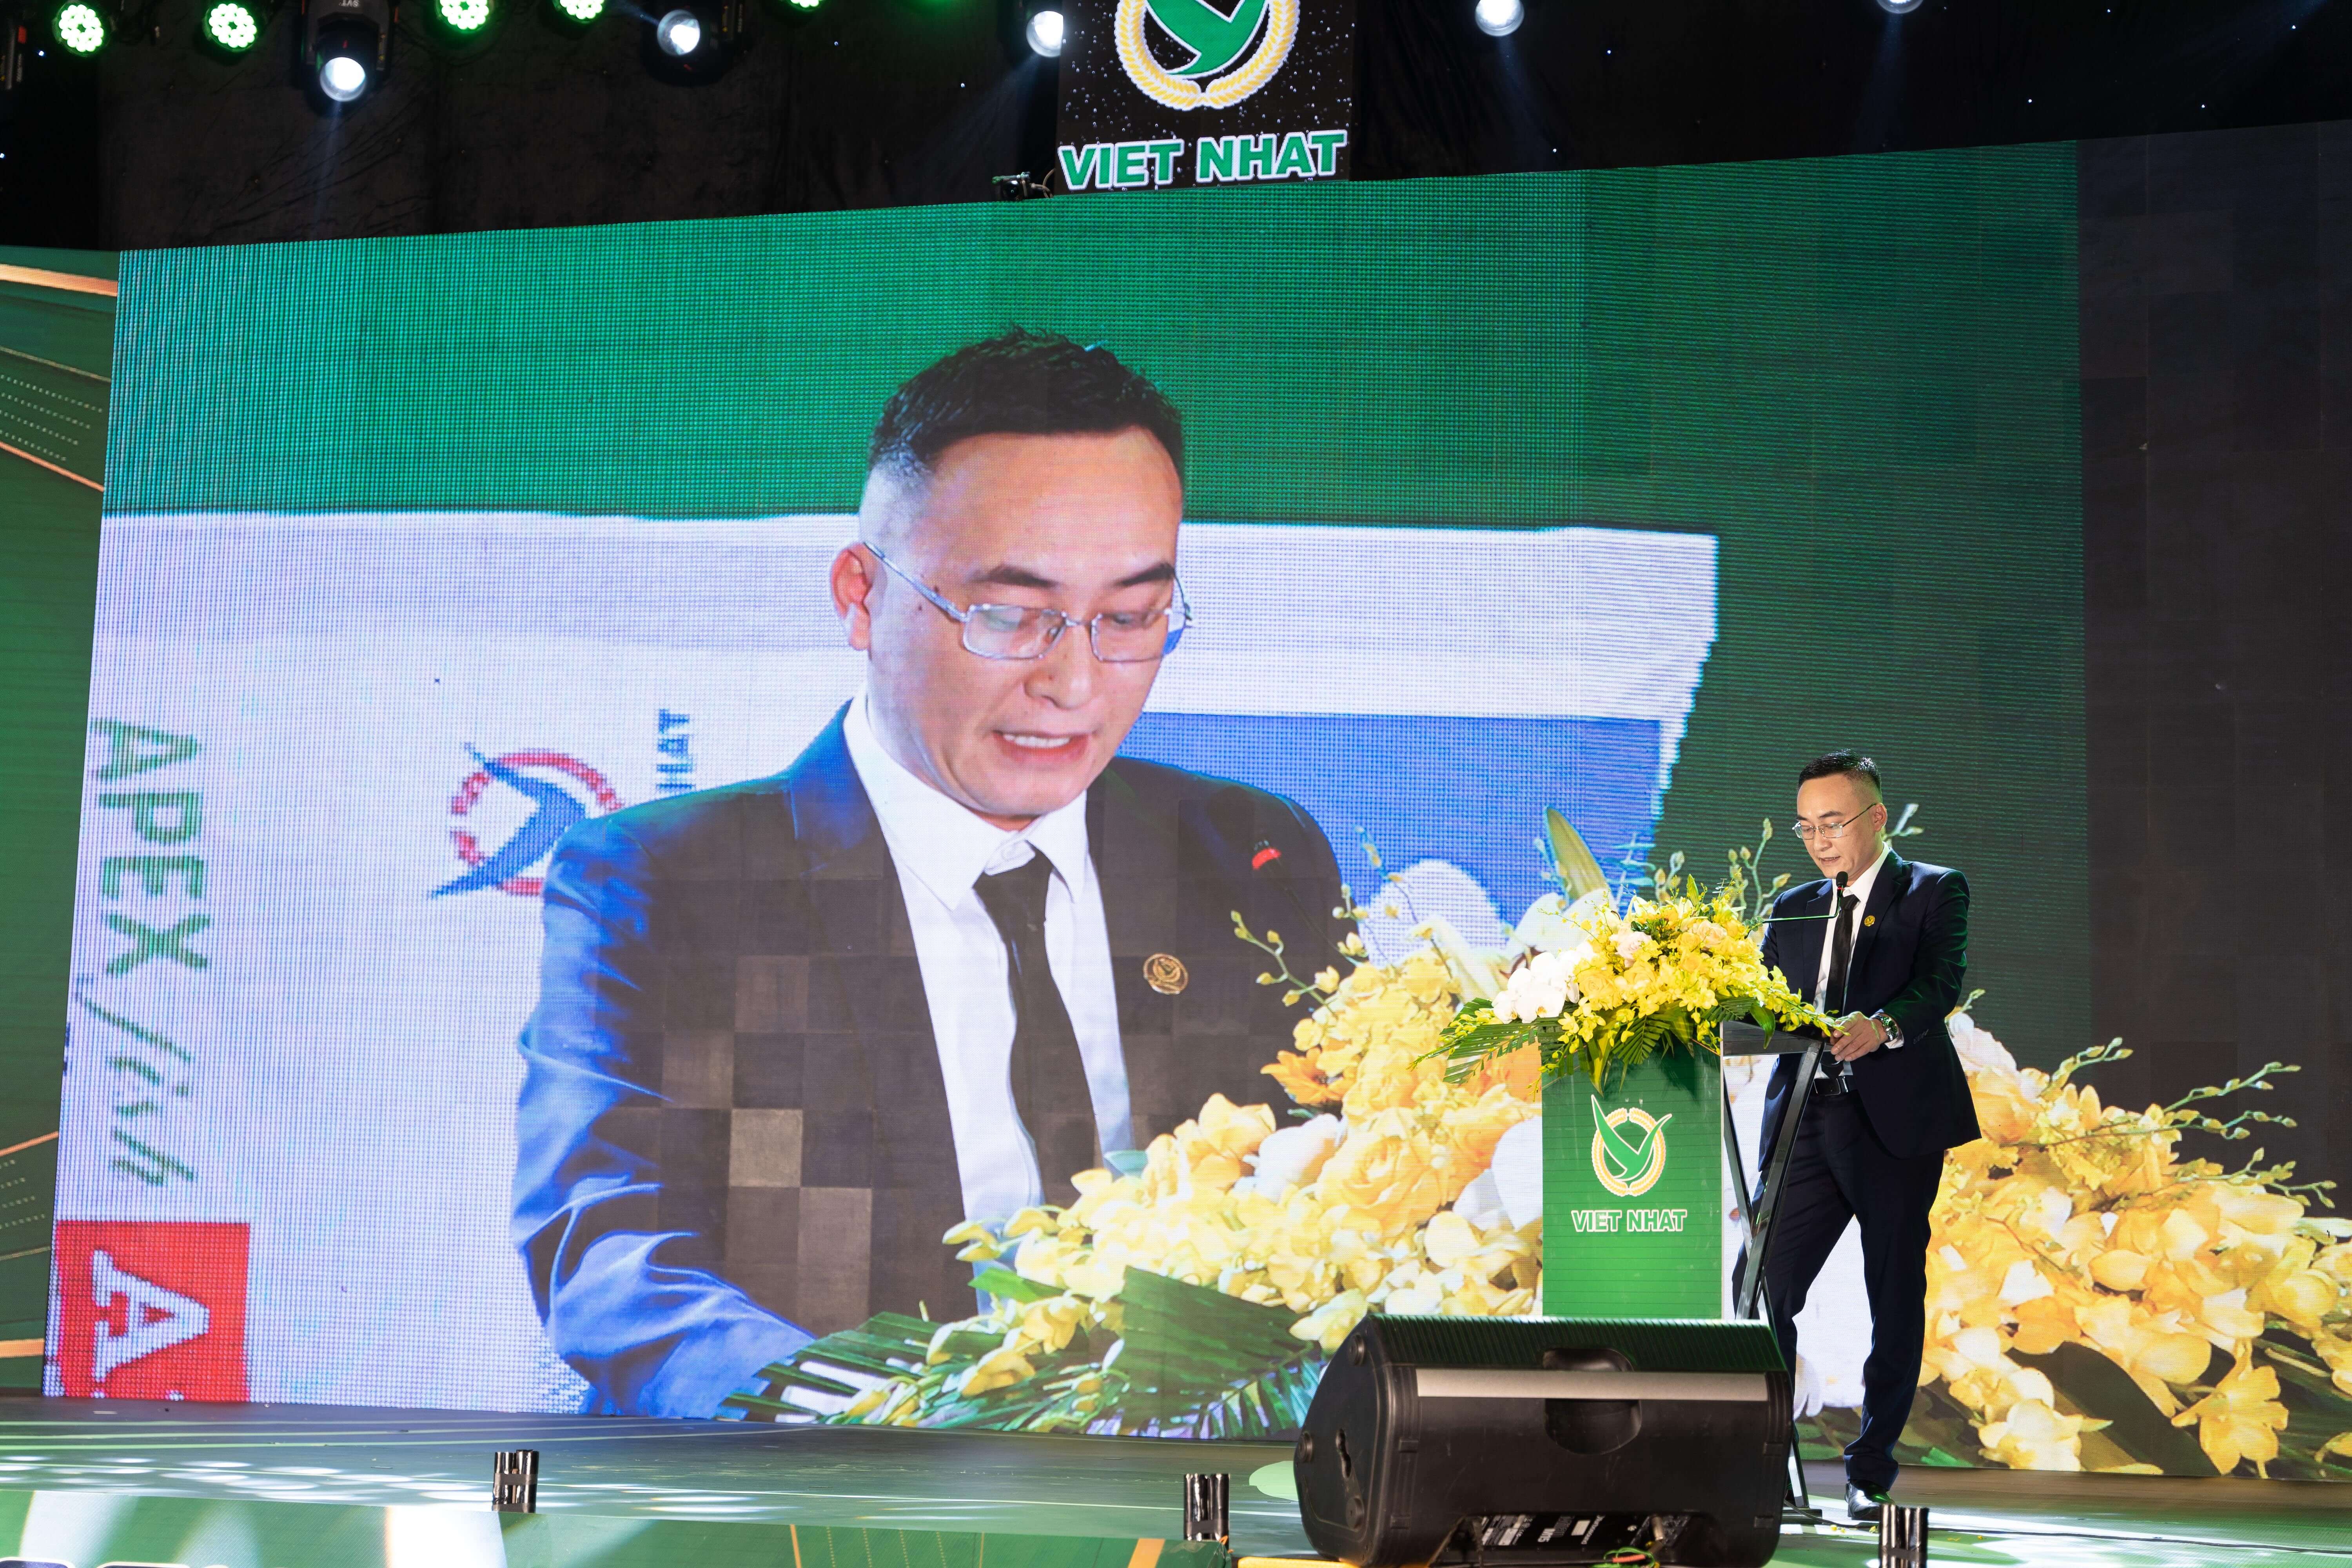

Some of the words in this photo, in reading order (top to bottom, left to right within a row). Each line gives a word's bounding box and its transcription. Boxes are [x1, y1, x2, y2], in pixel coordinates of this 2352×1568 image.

[1058, 139, 1184, 190] VIET
[1196, 130, 1348, 183] NHAT
[90, 717, 211, 978] APEX
[1571, 1210, 1622, 1232] VIET
[1626, 1209, 1688, 1232] NHAT
